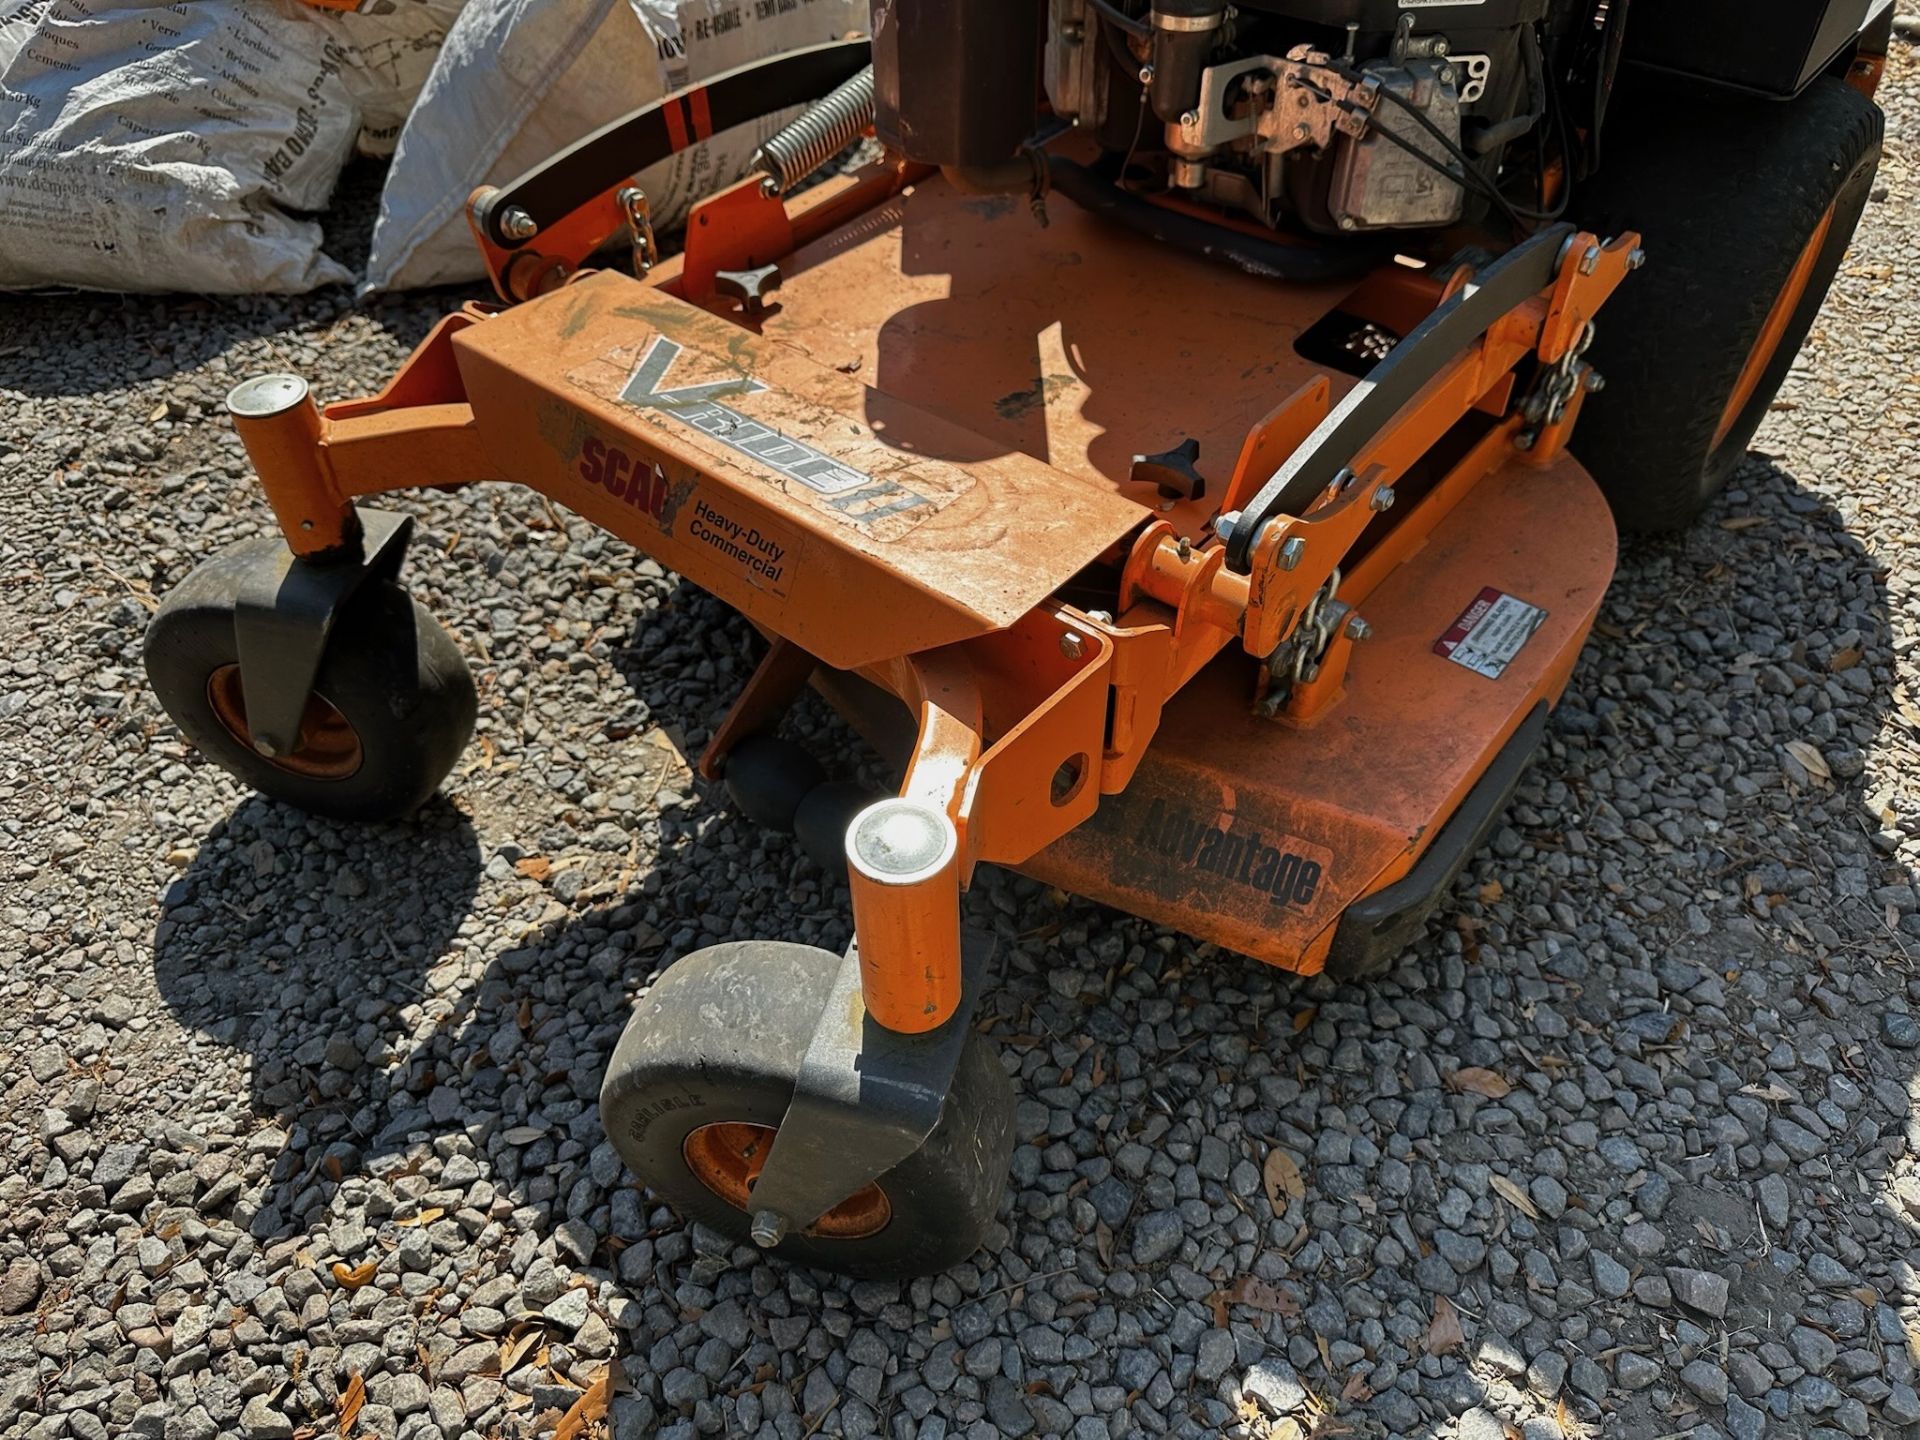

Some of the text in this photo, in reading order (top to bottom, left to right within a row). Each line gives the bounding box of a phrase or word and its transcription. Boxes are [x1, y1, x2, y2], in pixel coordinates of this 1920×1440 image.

[37, 26, 79, 49] loques
[150, 20, 181, 37] Verre
[225, 49, 261, 73] Brique
[694, 500, 786, 561] Heavy-Duty
[689, 520, 783, 582] Commercial
[1457, 600, 1492, 632] DANGER
[1138, 798, 1322, 907] Advantage
